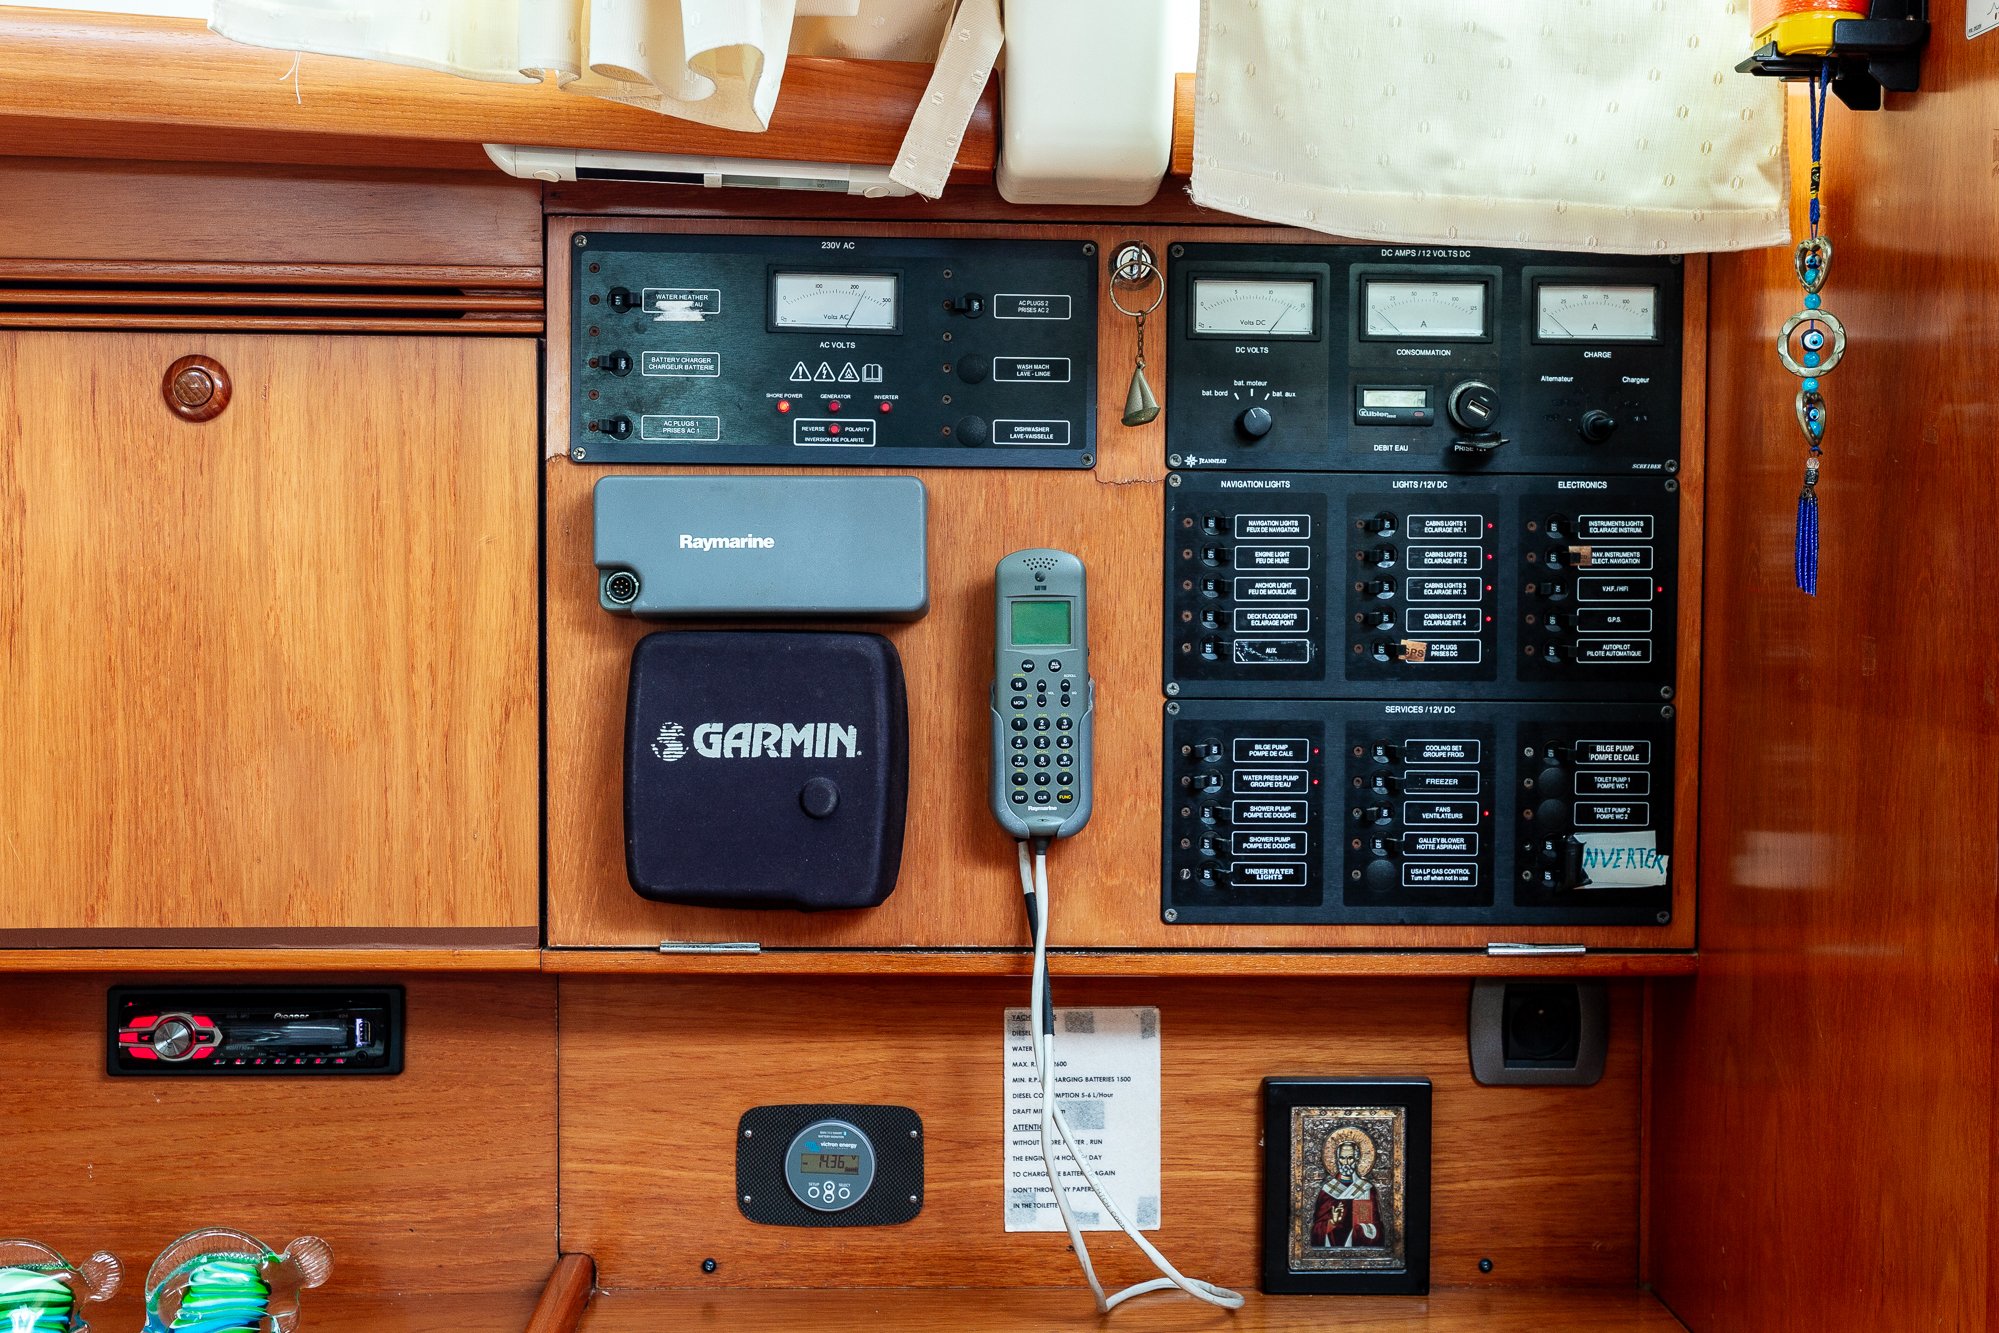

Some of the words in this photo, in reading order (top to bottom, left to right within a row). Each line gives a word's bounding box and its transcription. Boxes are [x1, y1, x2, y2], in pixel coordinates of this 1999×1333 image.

[1592, 323, 1598, 331] A
[1622, 376, 1650, 384] Chargeur
[680, 534, 774, 551] Raymarine
[693, 722, 857, 758] GARMIN
